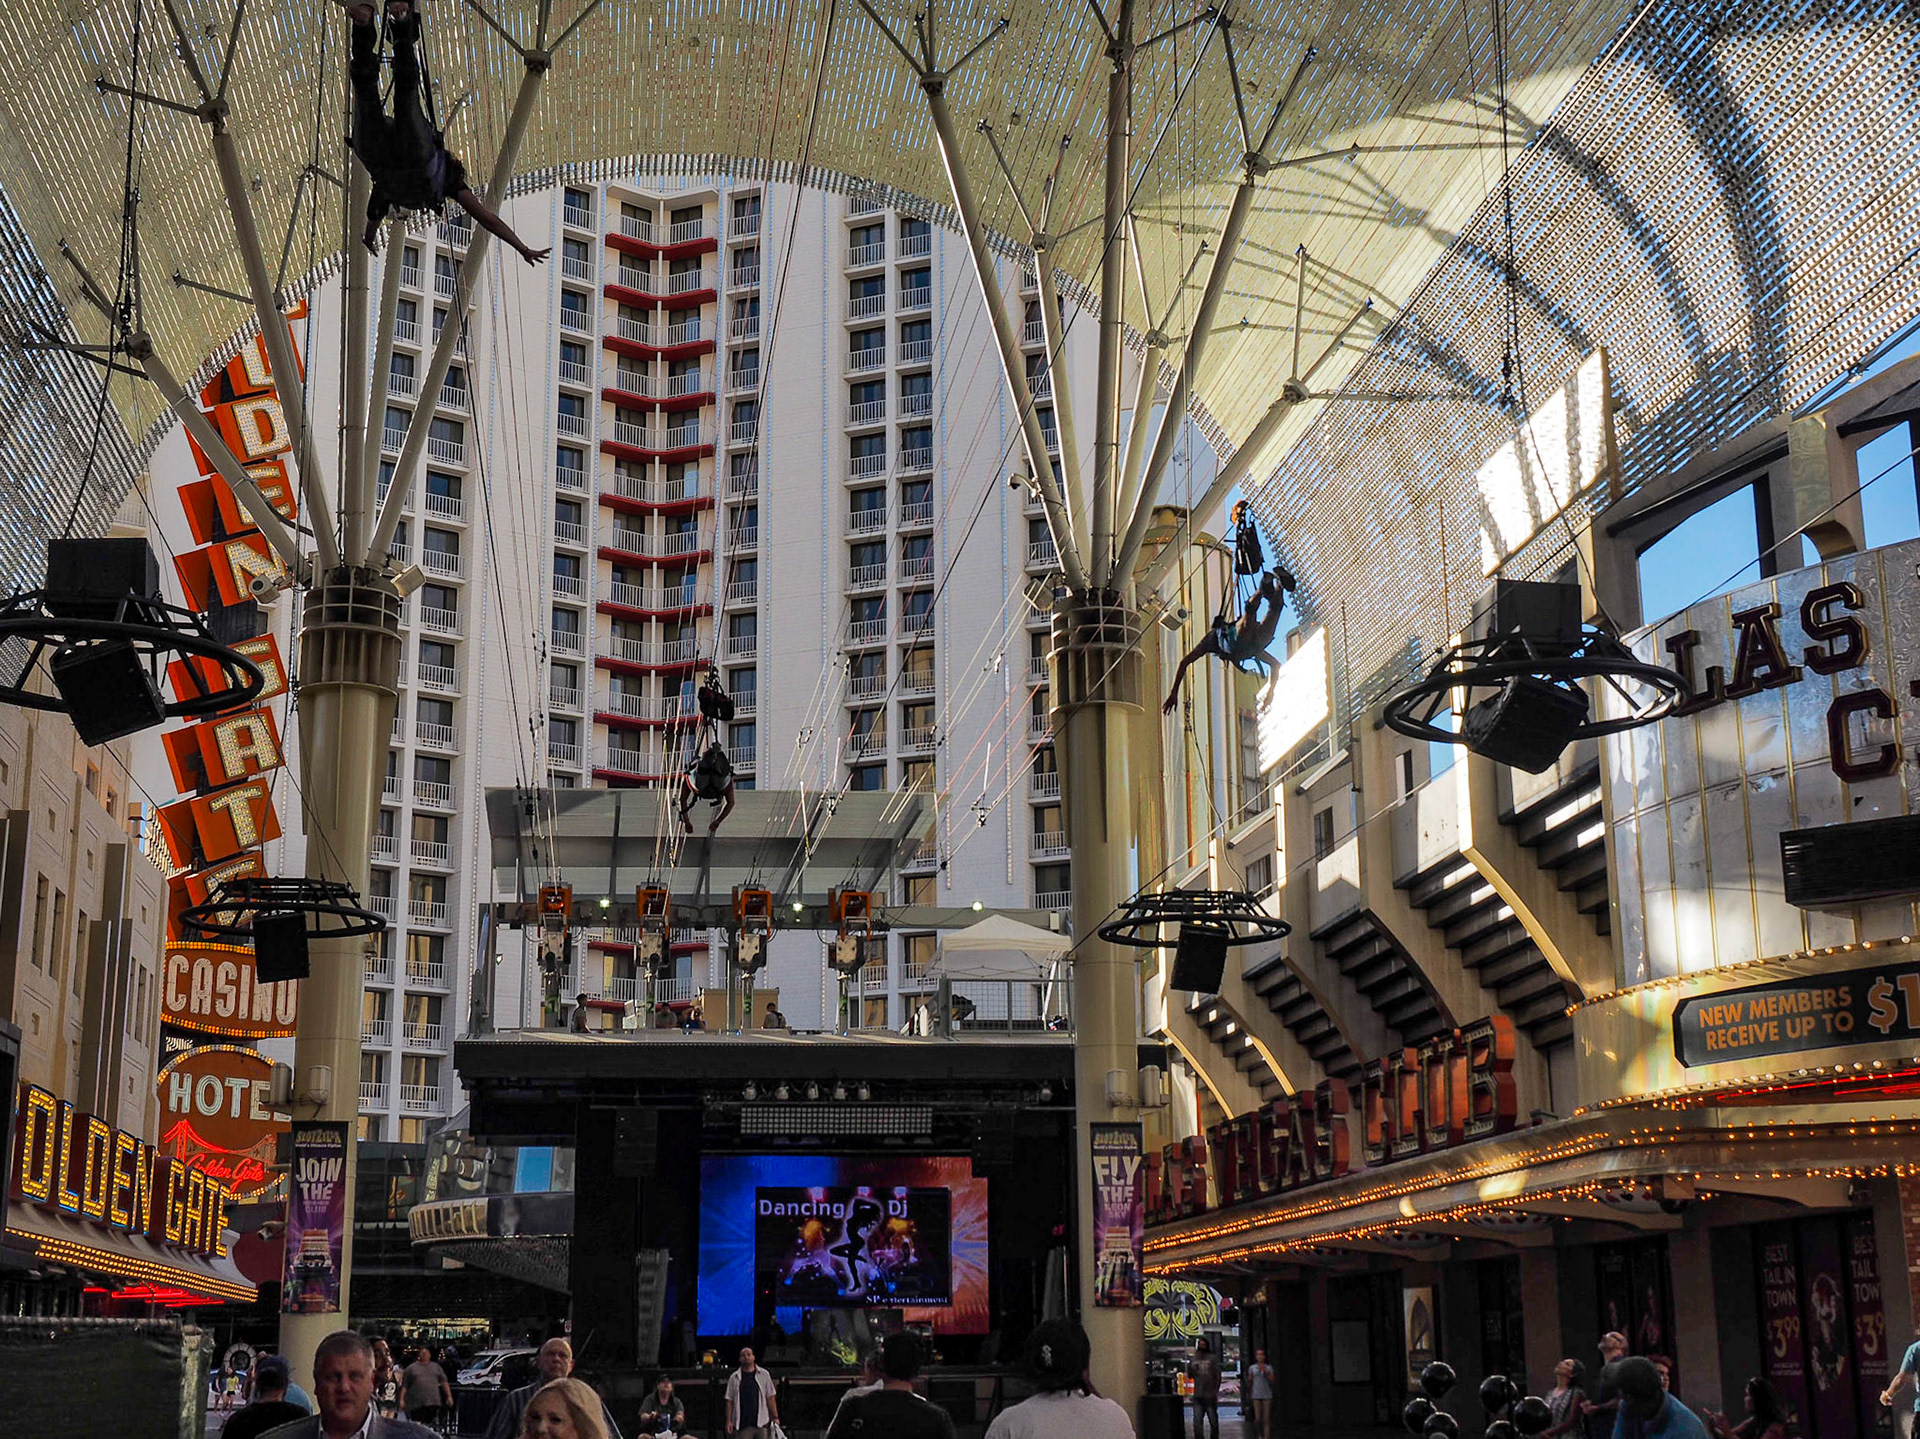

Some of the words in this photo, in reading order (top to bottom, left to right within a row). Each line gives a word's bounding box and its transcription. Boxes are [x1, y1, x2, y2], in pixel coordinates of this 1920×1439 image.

[1665, 581, 1871, 718] LAS
[1827, 686, 1912, 783] C
[166, 954, 298, 1025] CASINO
[1699, 1001, 1743, 1029] NEW
[1749, 986, 1853, 1021] MEMBERS
[1706, 1020, 1780, 1051] RECEIVE
[1786, 1015, 1816, 1039] UP
[1822, 1010, 1855, 1034] TO
[1206, 1081, 1348, 1206] VEGAS
[1360, 1015, 1514, 1166] CLUB
[18, 1083, 156, 1236] OLDEN
[165, 1156, 231, 1260] GATE
[230, 1159, 264, 1192] Gate
[295, 1157, 344, 1182] JOIN
[1093, 1156, 1141, 1186] FLY
[300, 1183, 335, 1200] THE
[1099, 1186, 1135, 1203] THE
[760, 1200, 845, 1219] Dancing
[888, 1200, 908, 1218] Dj
[1764, 1243, 1788, 1262] BEST
[1854, 1236, 1875, 1255] BES
[1763, 1268, 1782, 1284] TAIL
[1783, 1266, 1797, 1283] IN
[1765, 1289, 1797, 1308] TOWN
[1854, 1281, 1880, 1303] TOW
